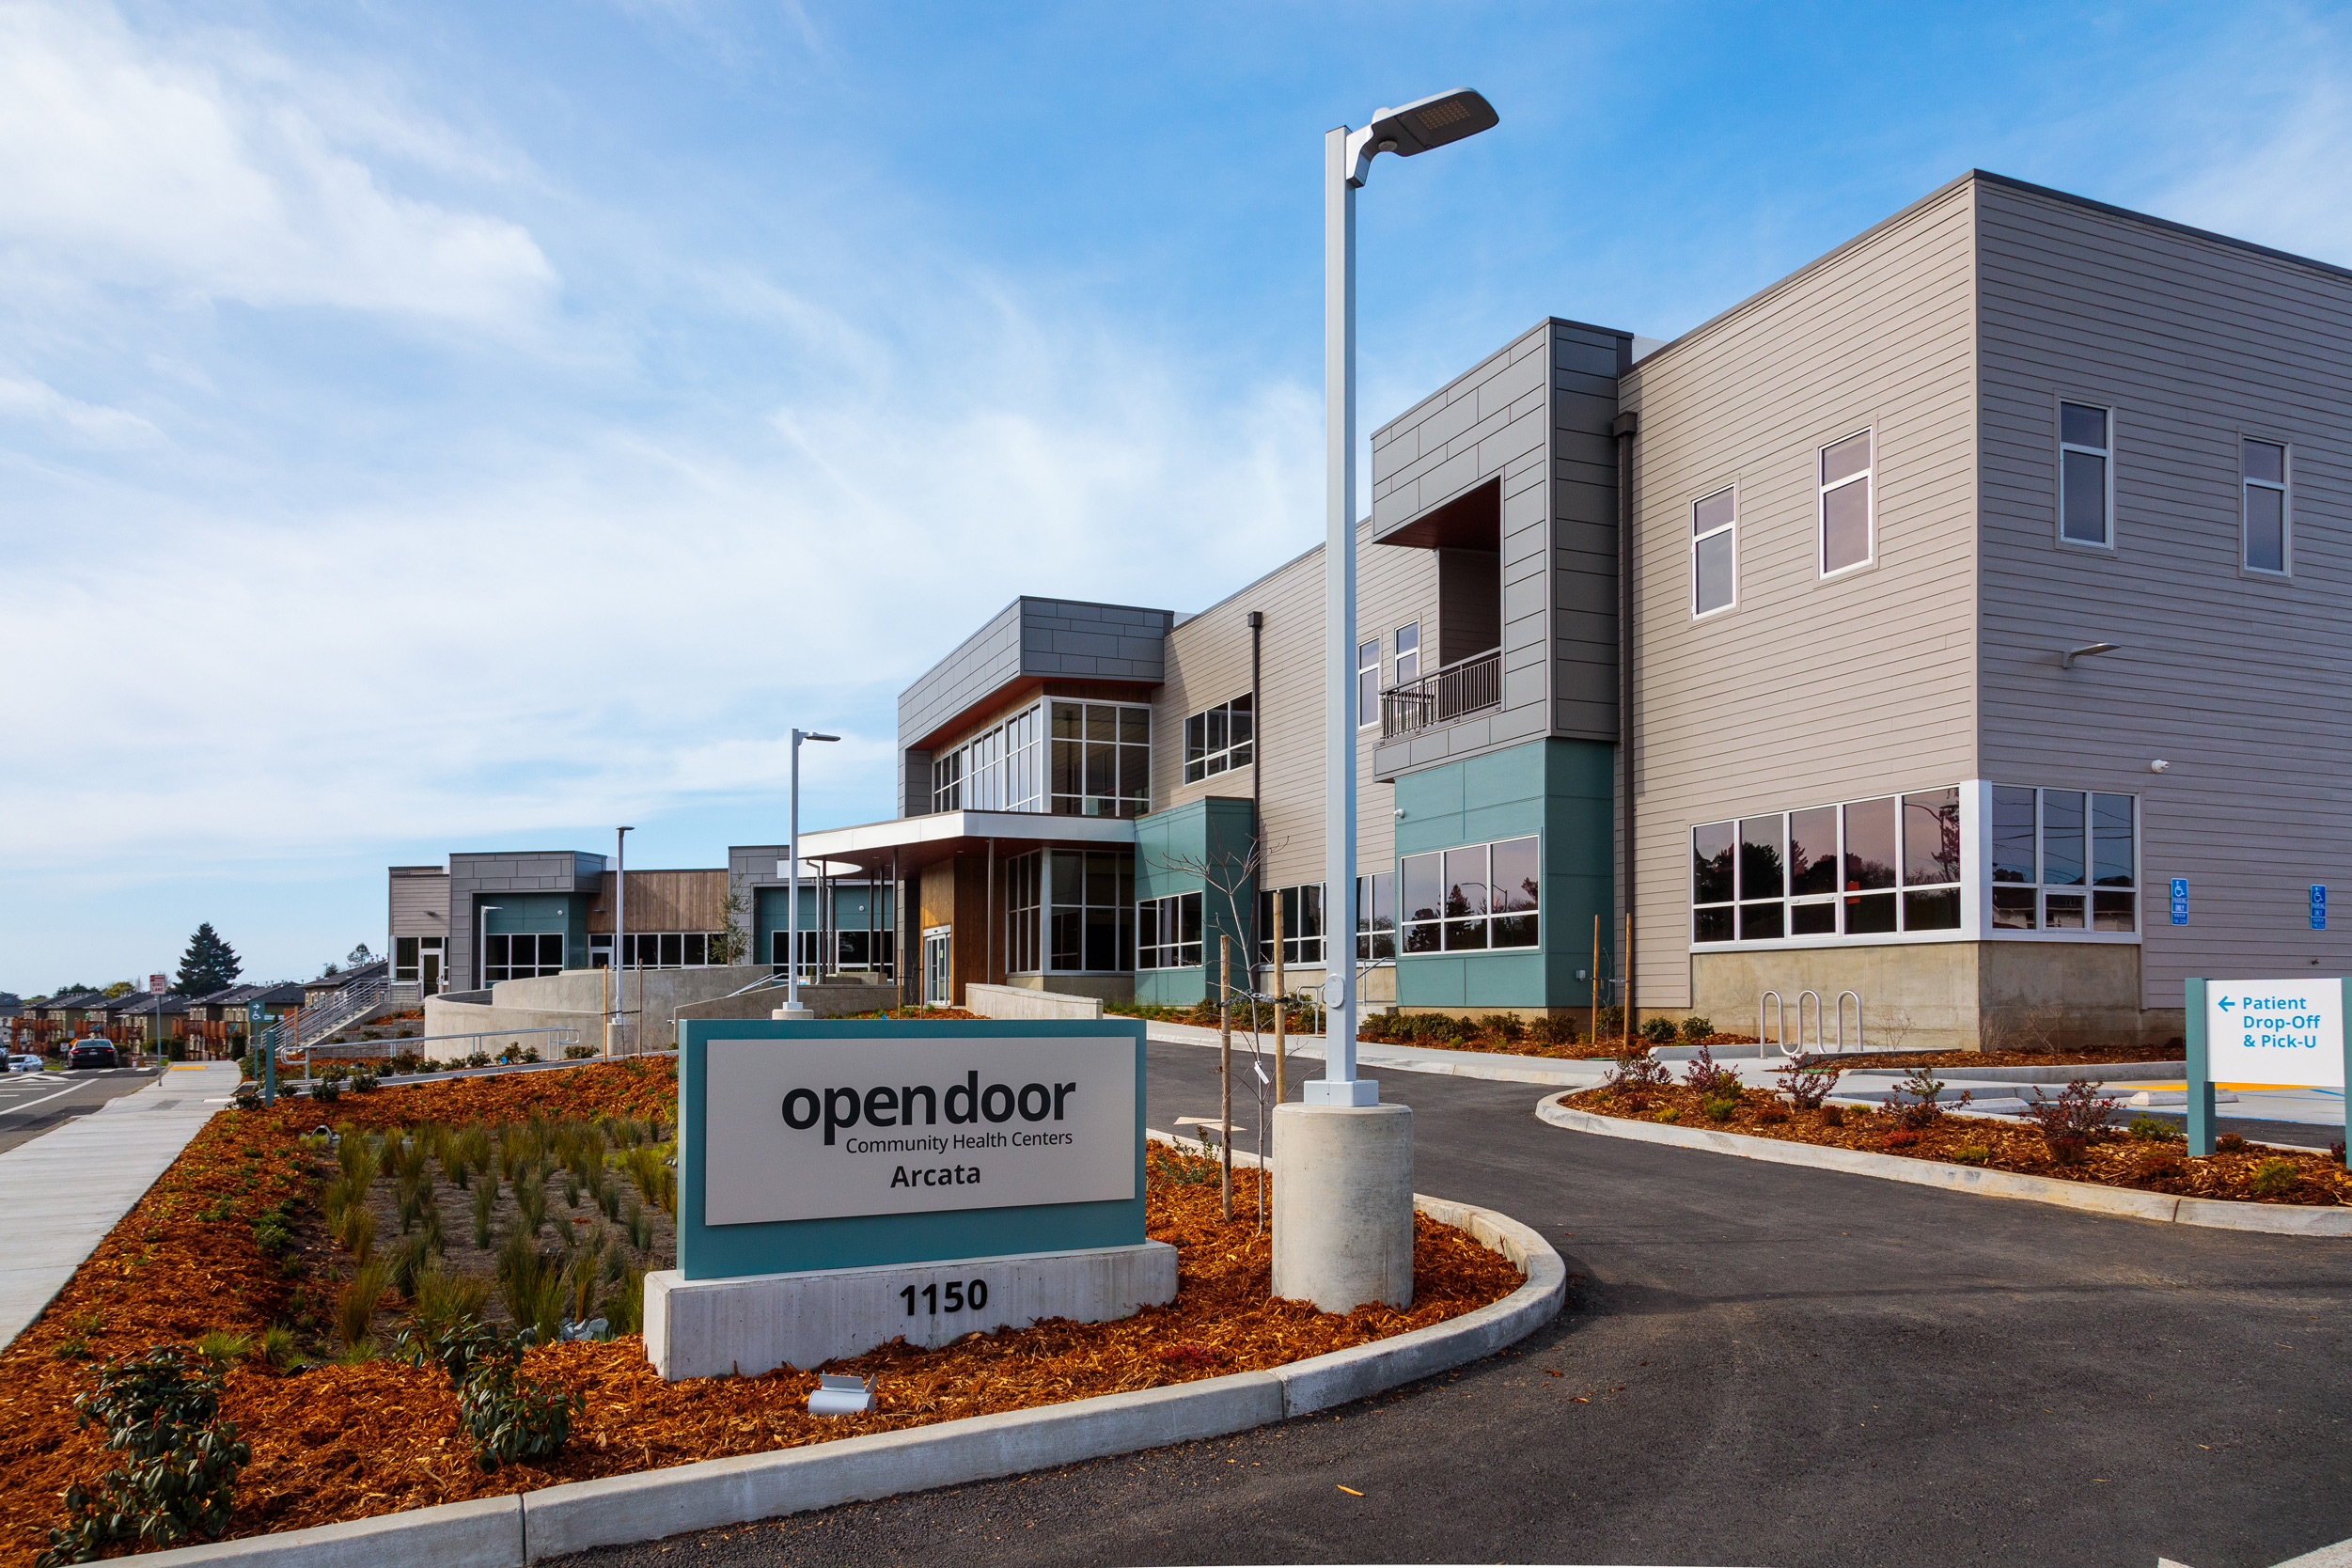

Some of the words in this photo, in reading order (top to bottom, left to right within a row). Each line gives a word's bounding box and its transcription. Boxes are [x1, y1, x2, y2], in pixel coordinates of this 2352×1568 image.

[2243, 996, 2307, 1010] Patient
[2243, 1014, 2321, 1033] Drop-Off
[2243, 1034, 2256, 1048] &
[2261, 1034, 2316, 1048] Pick-U
[845, 1136, 949, 1155] Community
[953, 1131, 1008, 1151] Health
[1011, 1131, 1074, 1147] Centers
[889, 1164, 981, 1189] Arcata
[898, 1278, 989, 1317] 1150
